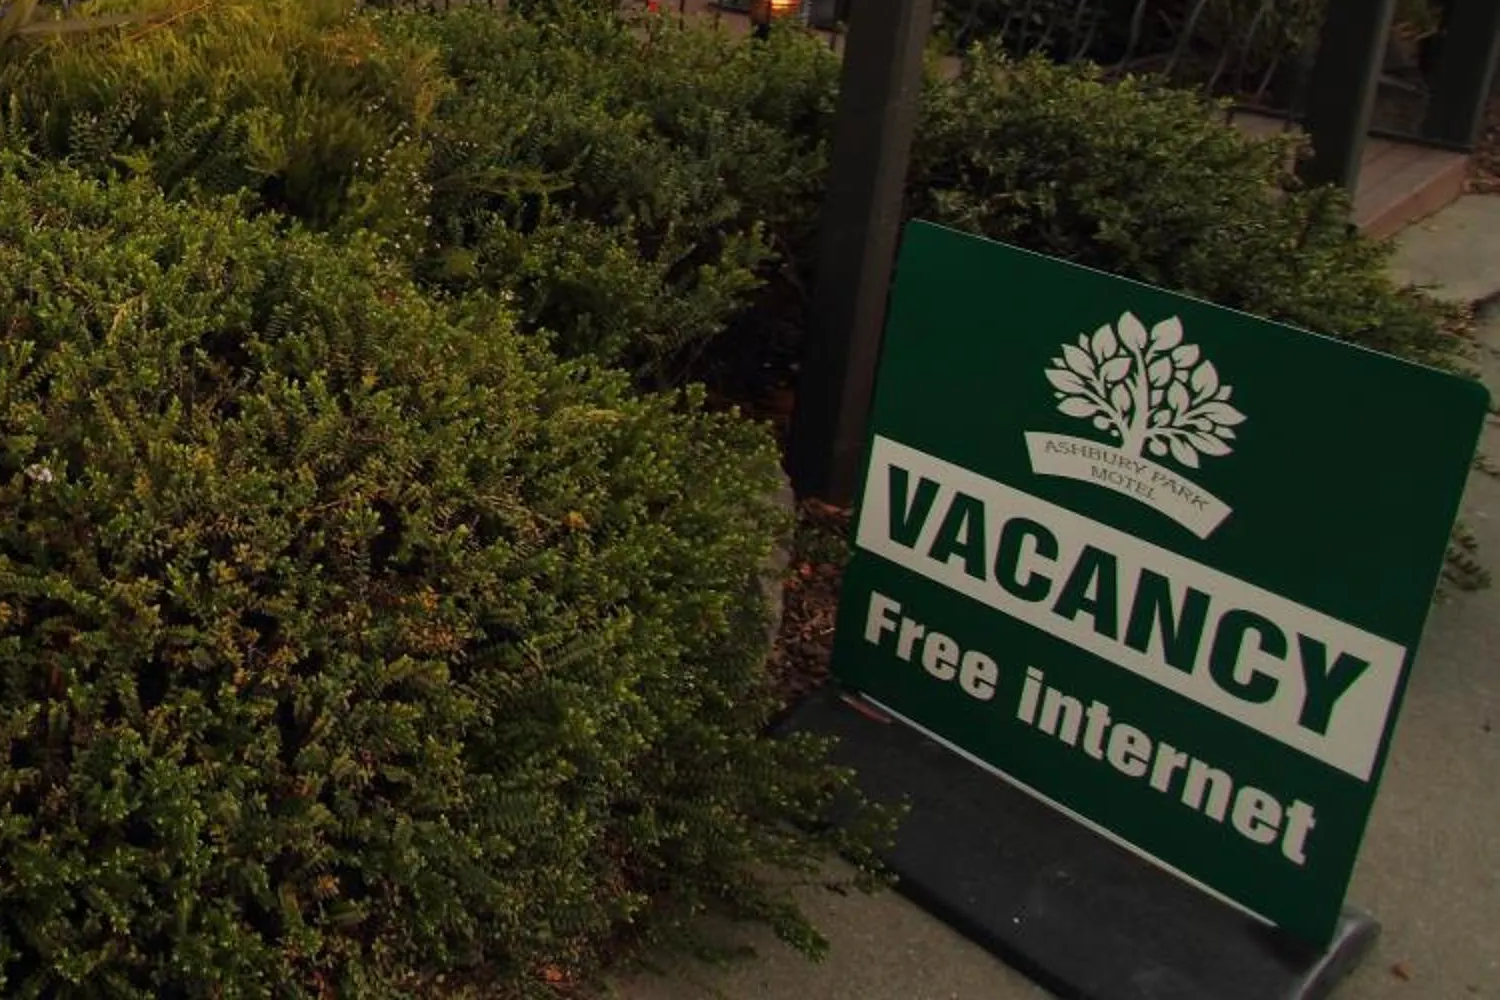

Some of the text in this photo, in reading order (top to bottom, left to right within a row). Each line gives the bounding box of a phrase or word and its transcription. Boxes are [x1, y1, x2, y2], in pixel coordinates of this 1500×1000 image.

[1044, 439, 1210, 511] ASHBURY PARK
[1090, 465, 1157, 501] MOTEL
[886, 462, 1370, 737] VACANCY
[863, 590, 1317, 865] Free internet
